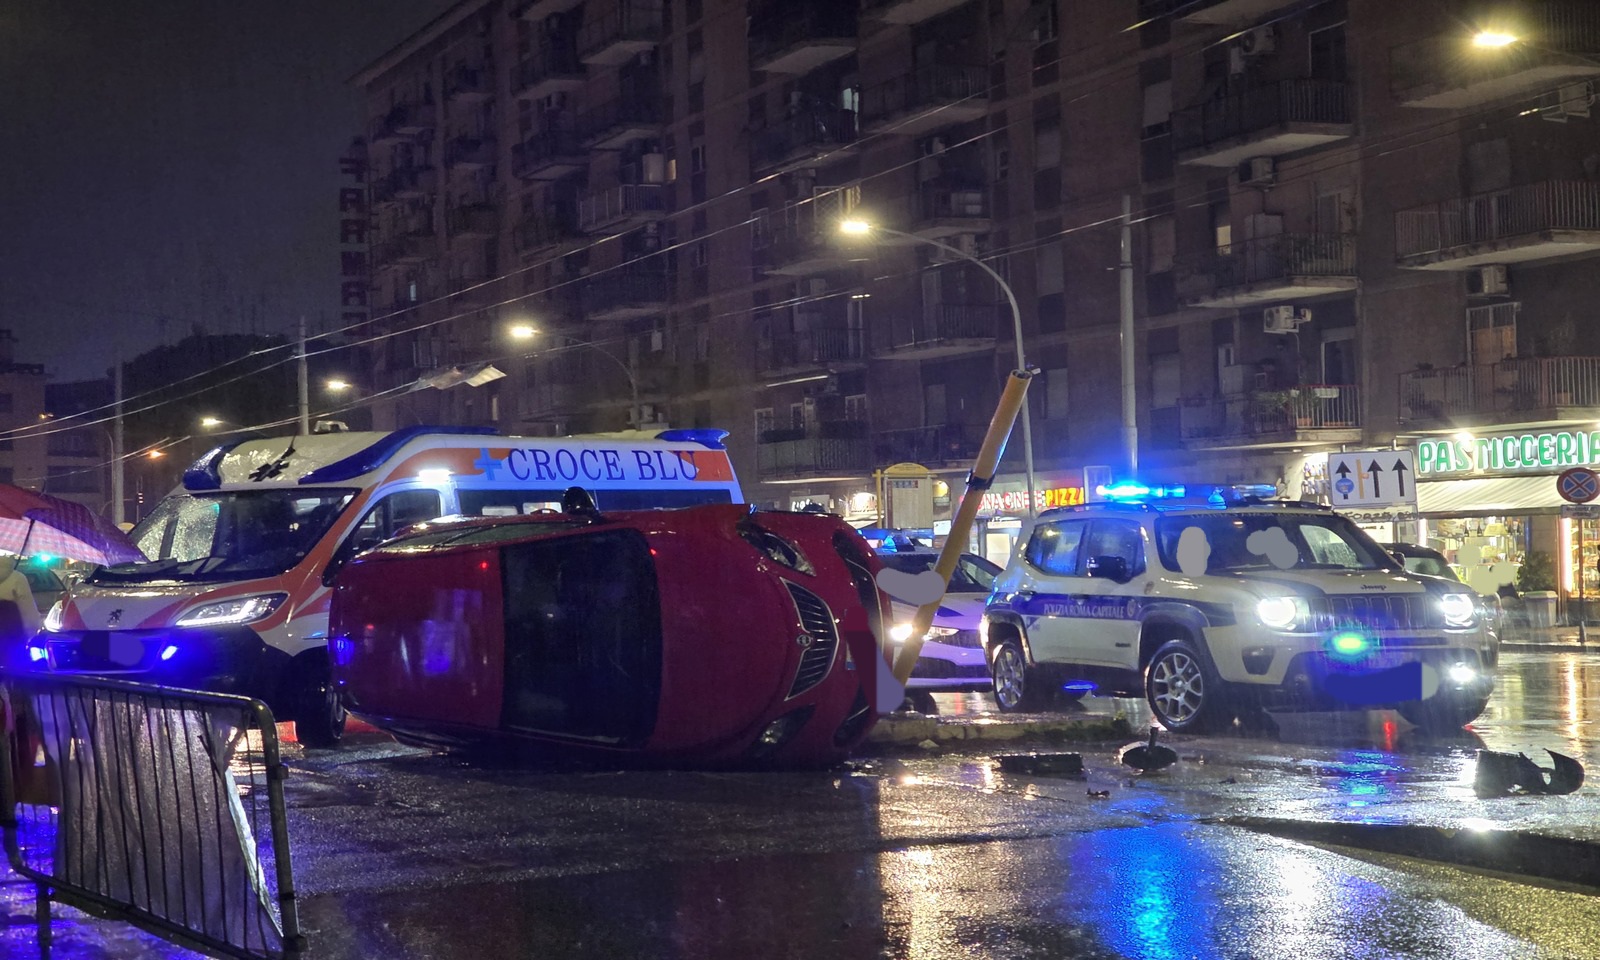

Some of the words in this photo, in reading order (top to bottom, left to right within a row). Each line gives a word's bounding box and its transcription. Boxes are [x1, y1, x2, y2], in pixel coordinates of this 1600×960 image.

[508, 448, 626, 481] CROCE
[631, 450, 697, 481] BLU
[1419, 431, 1600, 473] PASTICCERIA
[1043, 603, 1068, 616] POLIZIA
[1070, 604, 1091, 617] ROMA
[1091, 605, 1124, 618] CAPITALE
